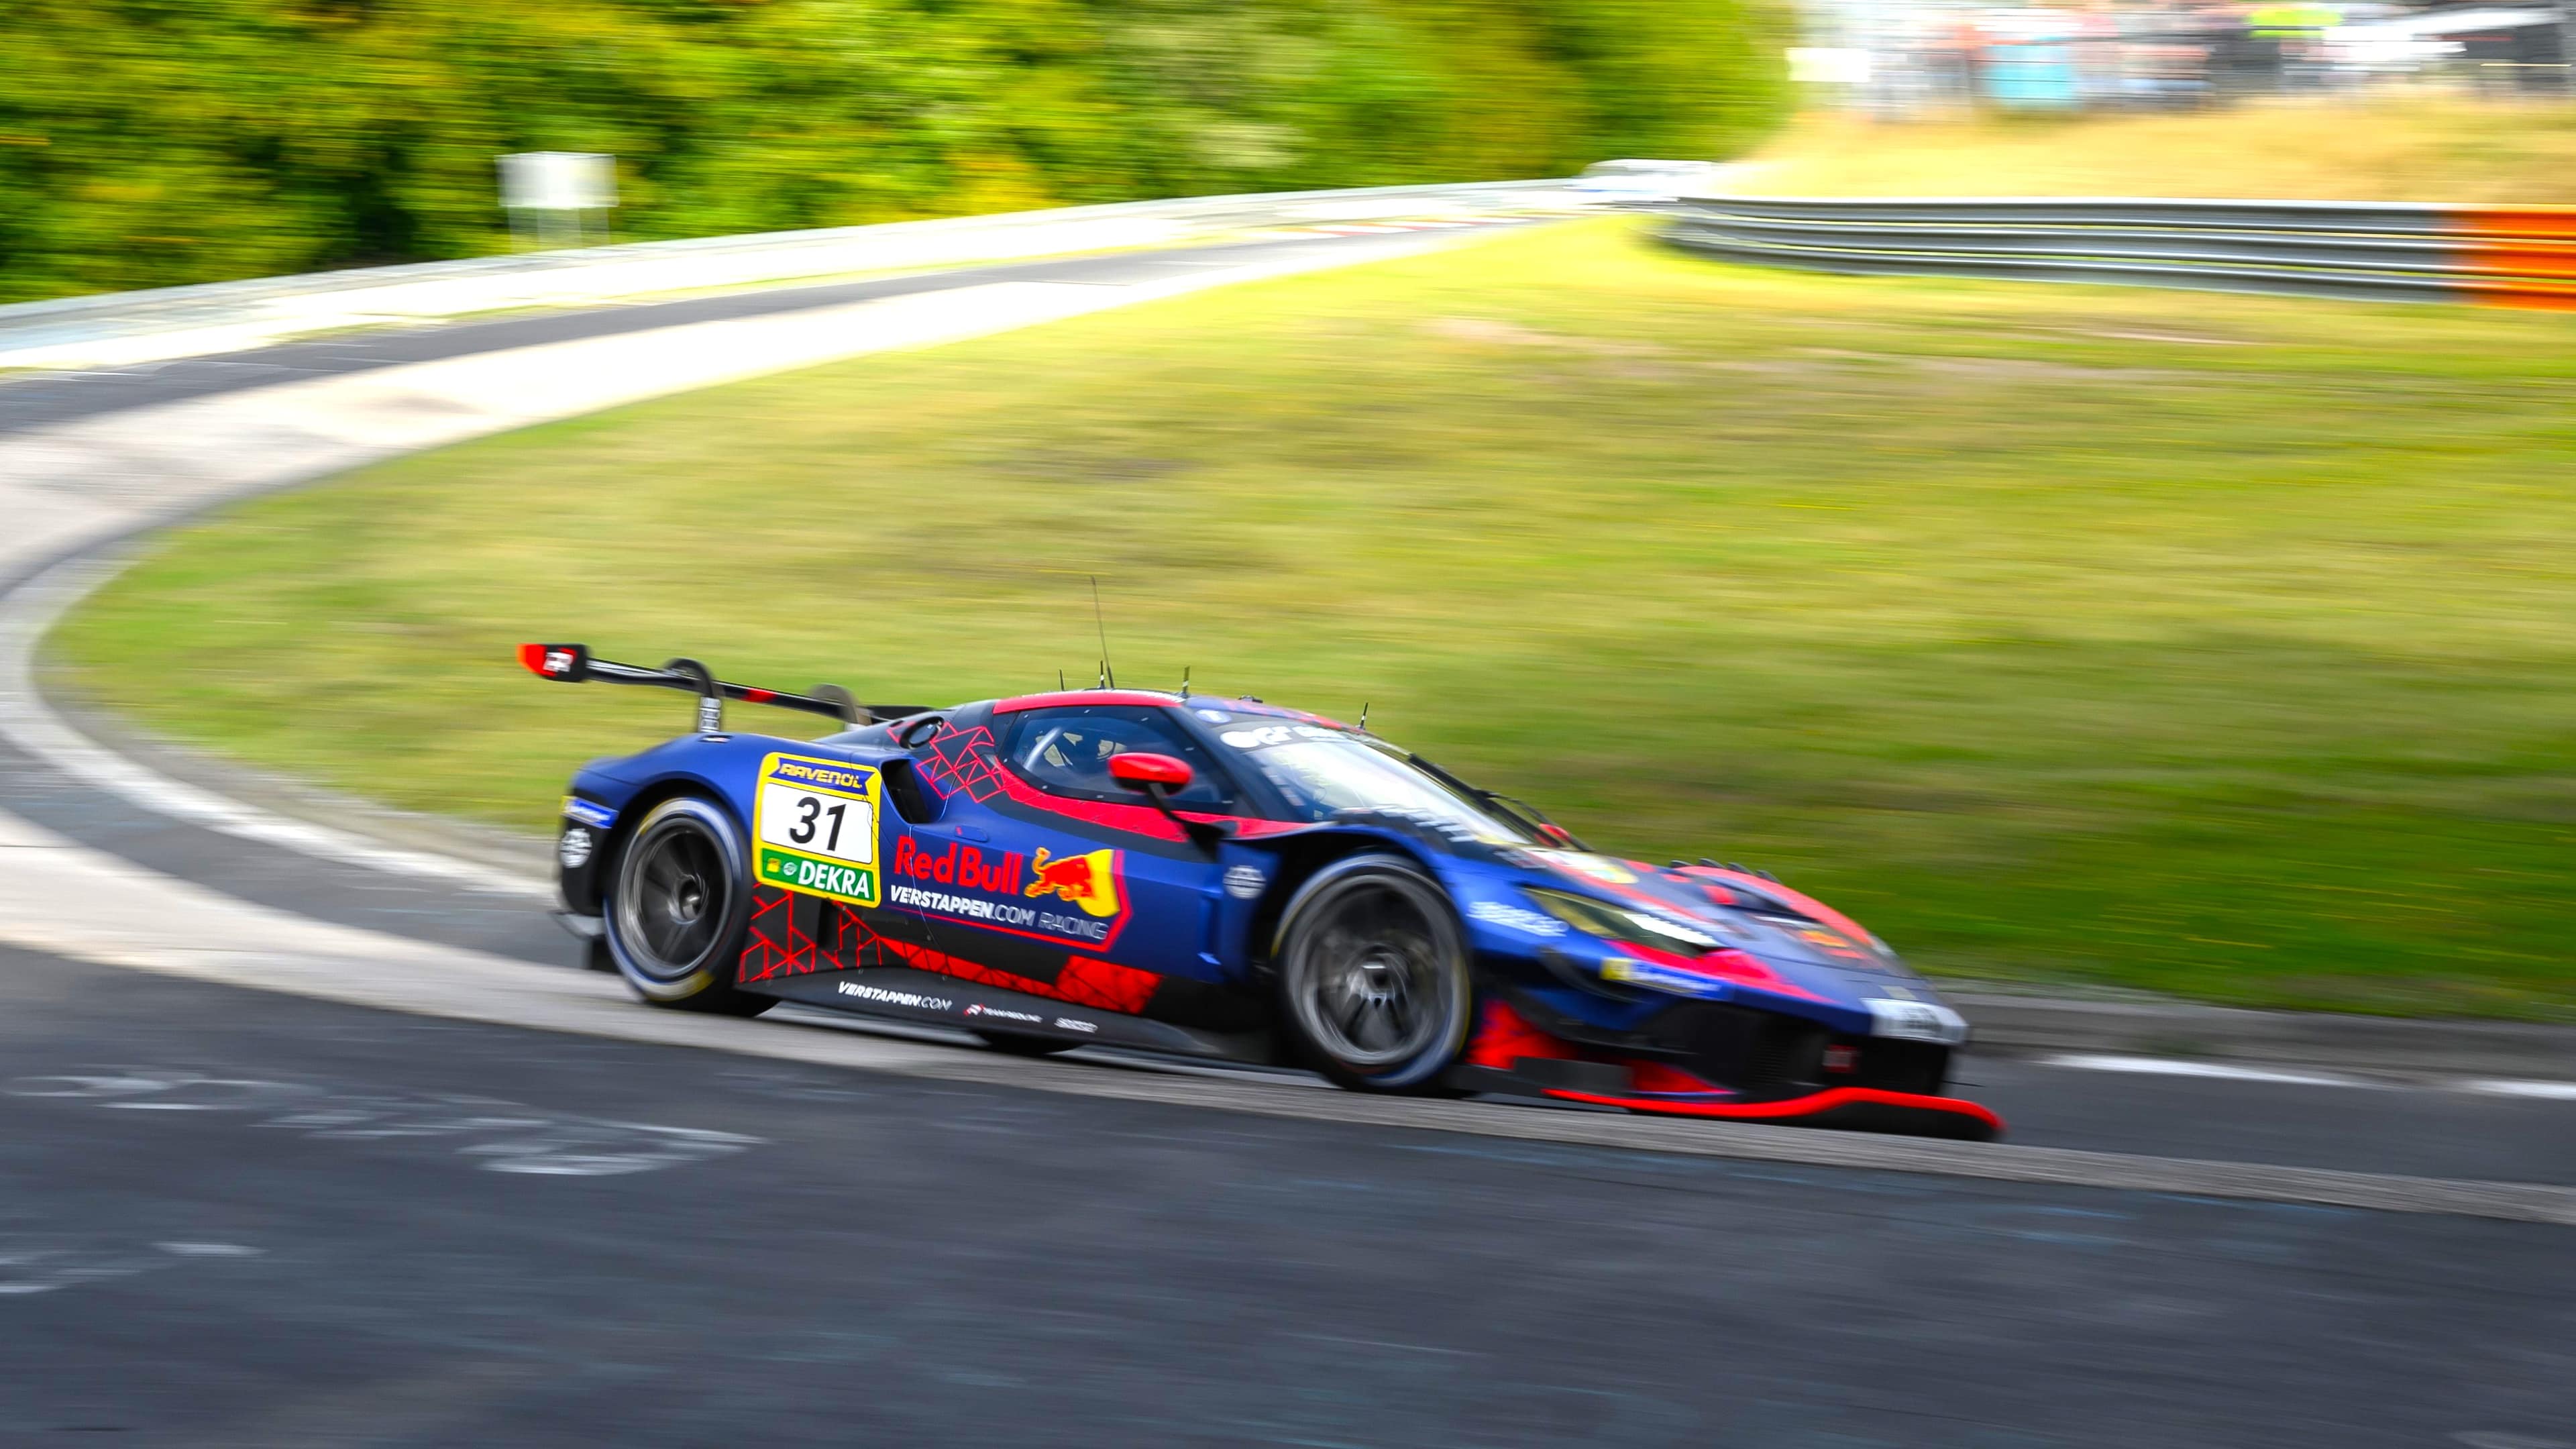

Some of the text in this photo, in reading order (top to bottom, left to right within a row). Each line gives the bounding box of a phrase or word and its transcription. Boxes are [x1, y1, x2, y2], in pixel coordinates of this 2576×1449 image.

[779, 763, 862, 788] RAVENOL
[790, 797, 847, 852] 31
[798, 861, 869, 898] DEKRA
[894, 836, 1024, 896] Red Bull
[891, 885, 1109, 939] VERSTAPPEN.COM RACING
[839, 981, 953, 1011] VERSTAPPEN.COM
